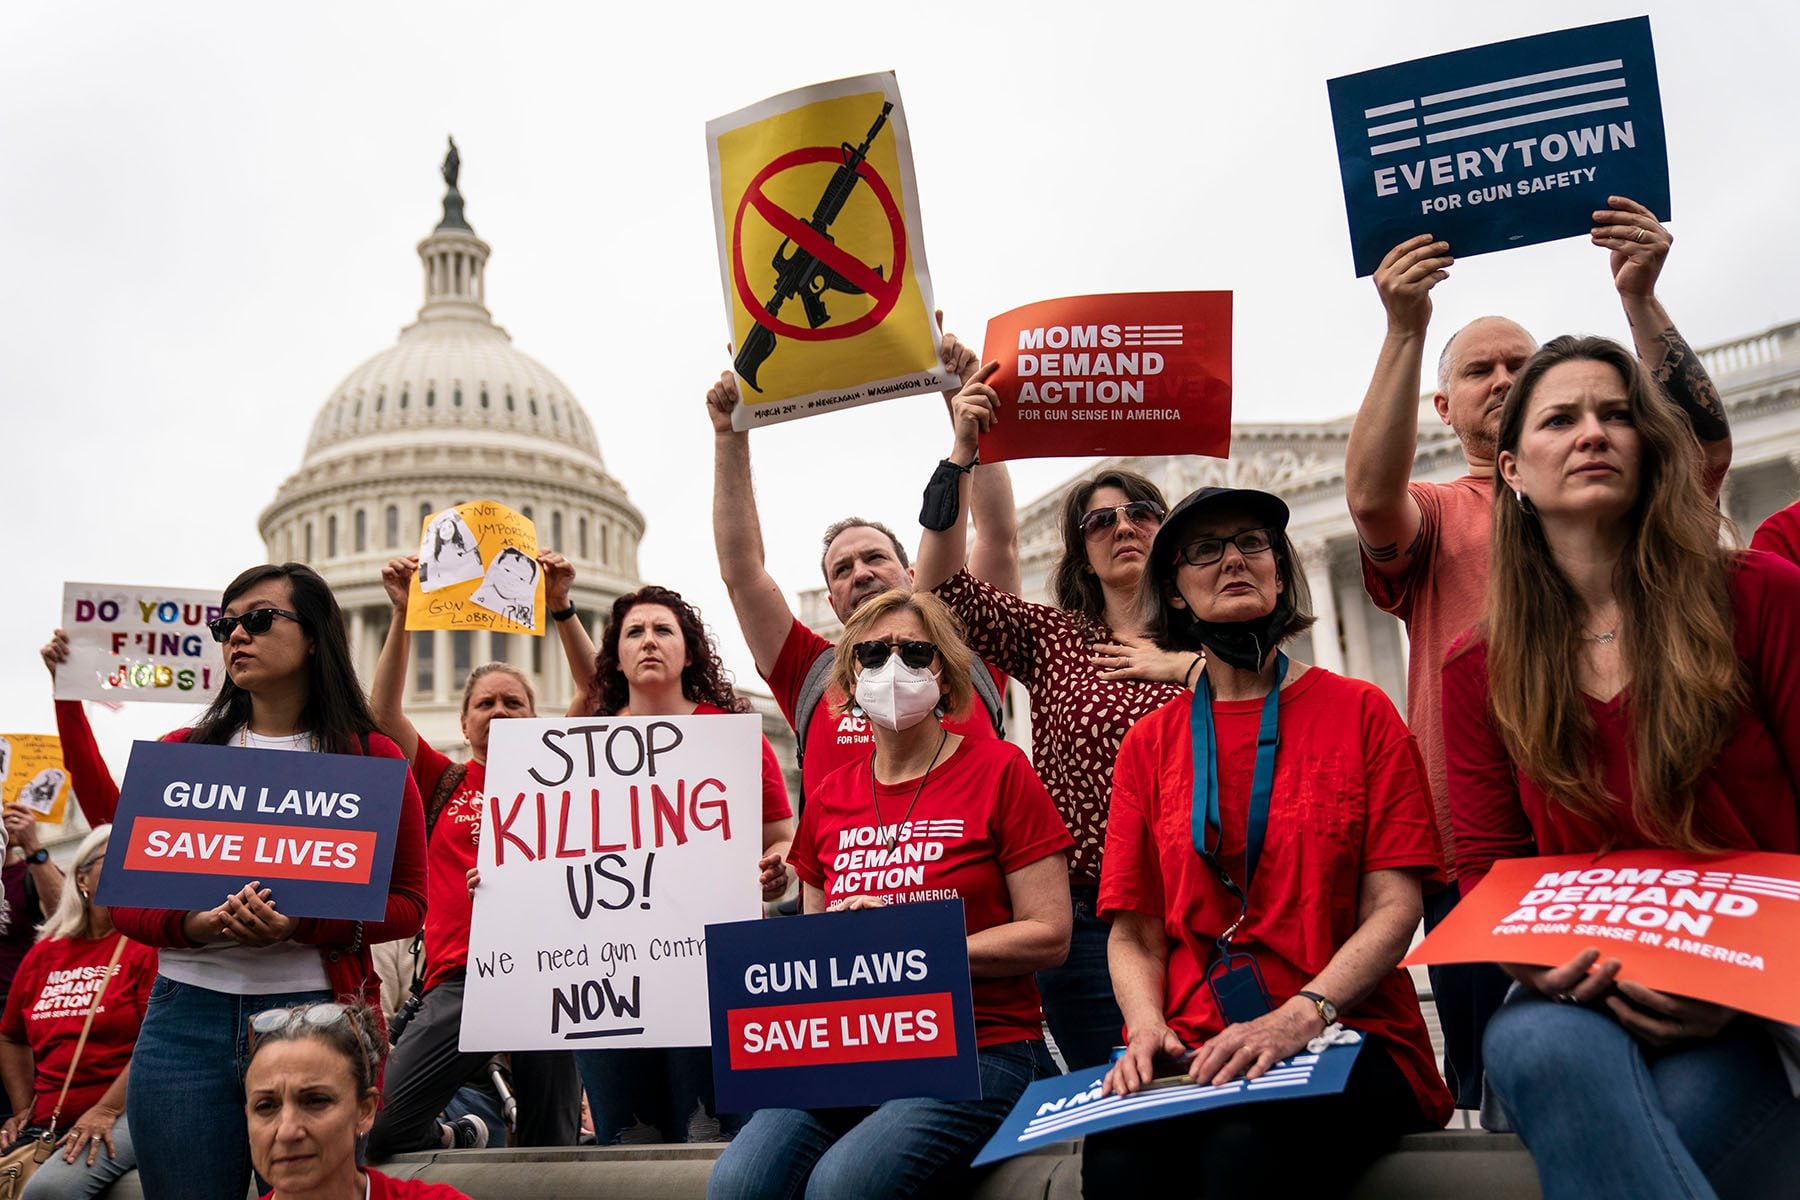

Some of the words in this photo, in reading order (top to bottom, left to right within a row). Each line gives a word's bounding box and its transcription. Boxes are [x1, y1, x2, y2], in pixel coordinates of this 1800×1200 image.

[1374, 120, 1636, 197] EVERYTOWN
[1421, 193, 1462, 215] FOR
[1466, 182, 1512, 205] GUN
[1517, 166, 1597, 195] SAFETY
[1018, 324, 1122, 350] MOMS
[1017, 352, 1164, 377] DEMAND
[754, 406, 780, 419] MARCH
[867, 380, 921, 396] WASHINGTON
[923, 376, 942, 386] D.C.
[1017, 380, 1144, 404] ACTION
[1018, 409, 1040, 420] FOR
[1044, 409, 1068, 420] GUN
[1071, 409, 1108, 420] SENSE
[1111, 409, 1122, 420] IN
[1126, 409, 1181, 420] AMERICA
[473, 504, 497, 517] NOT
[75, 599, 119, 623] DO
[428, 598, 464, 615] GUN
[108, 664, 211, 691] JOBS!
[527, 721, 683, 787] STOP
[836, 735, 852, 745] FOR
[162, 781, 247, 811] GUN
[256, 787, 361, 819] LAWS
[489, 778, 732, 867] KILLING
[838, 821, 913, 850] MOMS
[143, 829, 244, 862] SAVE
[253, 836, 358, 869] LIVES
[833, 841, 944, 872] DEMAND
[566, 852, 656, 920] US!
[831, 865, 925, 895] ACTION
[1534, 867, 1699, 889] MOMS
[896, 892, 907, 904] IN
[909, 888, 959, 903] AMERICA
[1519, 885, 1758, 917] DEMAND
[1501, 903, 1713, 937] ACTION
[537, 944, 589, 973] need
[601, 942, 637, 978] gun
[649, 936, 706, 961] contr
[1492, 924, 1528, 936] FOR
[1531, 923, 1571, 935] GUN
[1573, 923, 1637, 942] SENSE
[1638, 930, 1661, 947] IN
[1664, 937, 1765, 971] AMERICA
[744, 959, 818, 995] GUN
[829, 949, 928, 988] LAWS
[33, 992, 94, 1012] ACTION
[551, 975, 641, 1034] NOW
[743, 1017, 830, 1054] SAVE
[840, 1008, 939, 1047] LIVES
